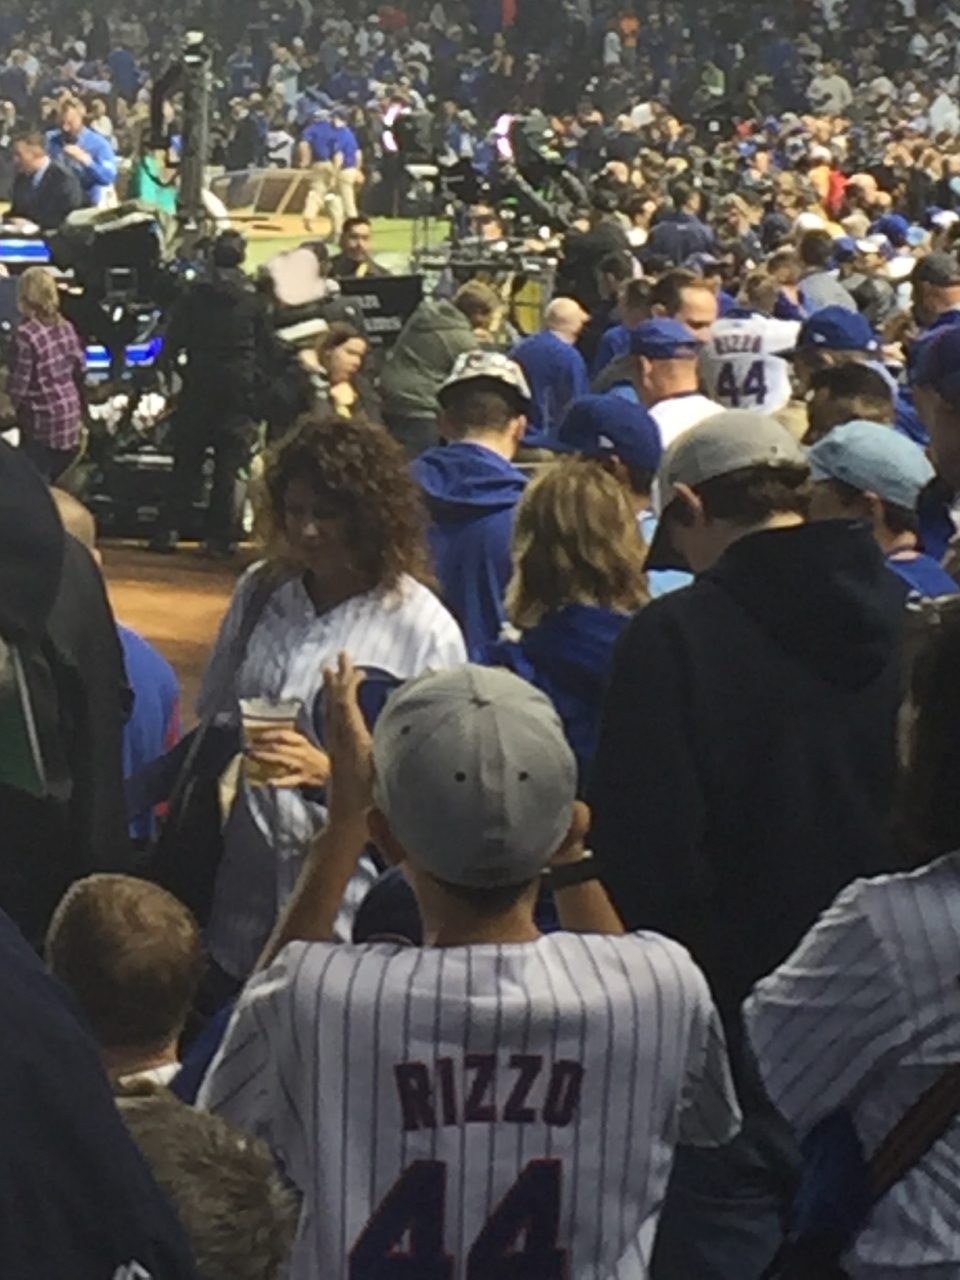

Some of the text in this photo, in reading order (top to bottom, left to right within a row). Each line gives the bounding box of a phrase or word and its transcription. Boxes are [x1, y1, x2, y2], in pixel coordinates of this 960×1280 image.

[714, 334, 762, 355] RIZZO
[718, 361, 768, 407] 44
[394, 1053, 584, 1131] RIZZO
[348, 1157, 570, 1280] 44
